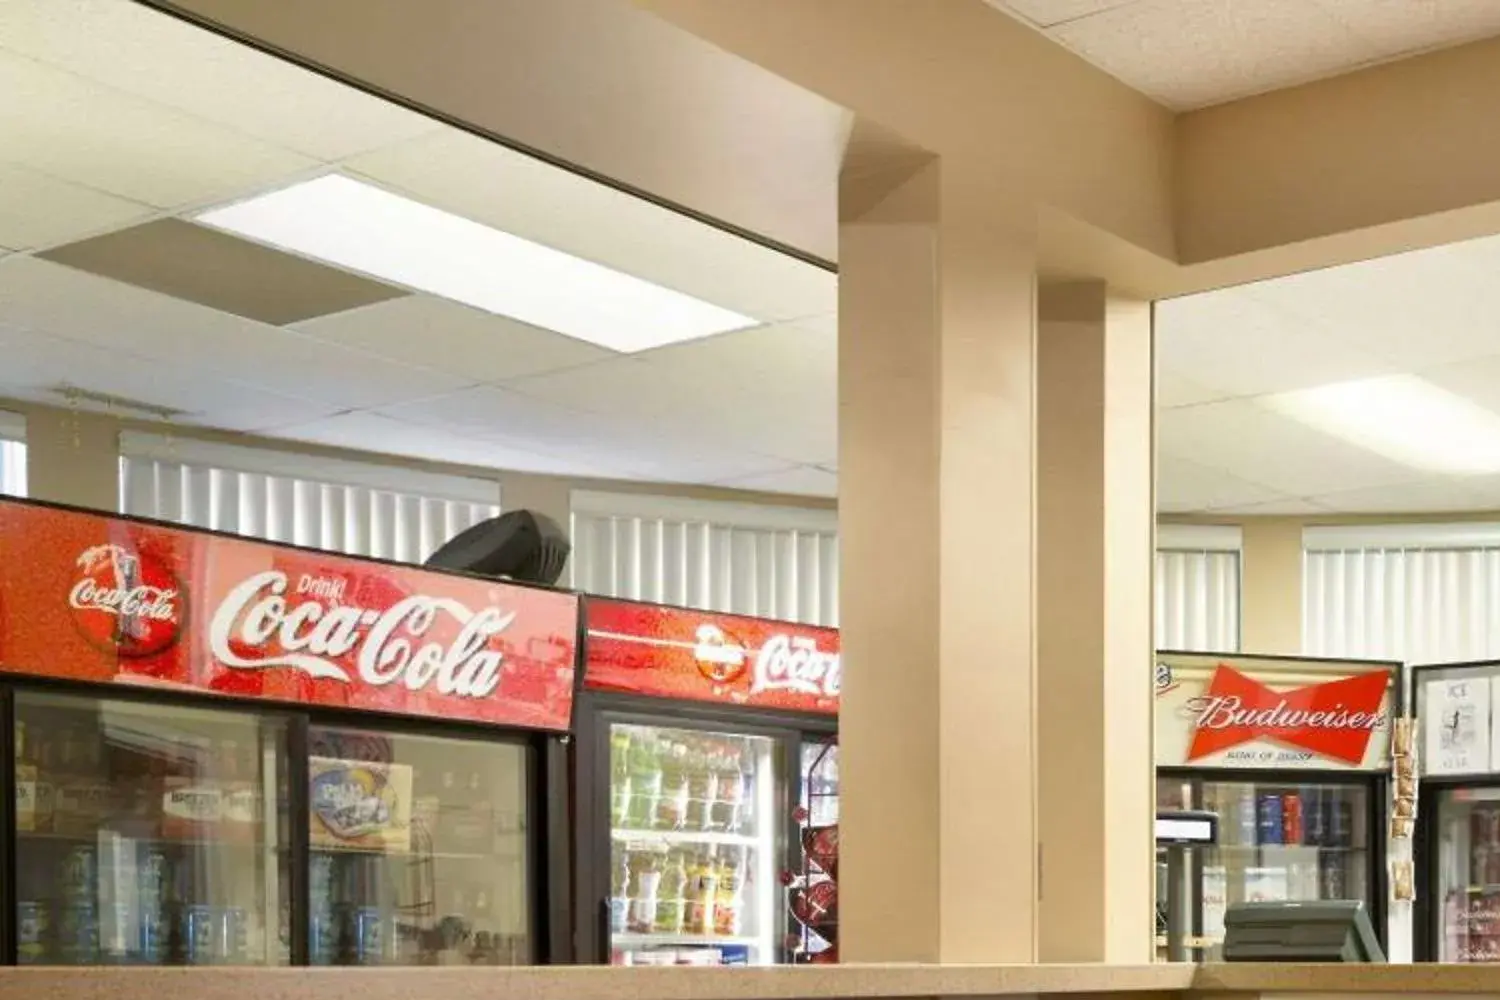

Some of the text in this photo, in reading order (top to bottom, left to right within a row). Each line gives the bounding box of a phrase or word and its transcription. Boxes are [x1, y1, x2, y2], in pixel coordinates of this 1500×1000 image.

[69, 577, 178, 620] Coca-Cola
[209, 570, 516, 698] Coca-Cola
[1186, 695, 1387, 730] Budweiser
